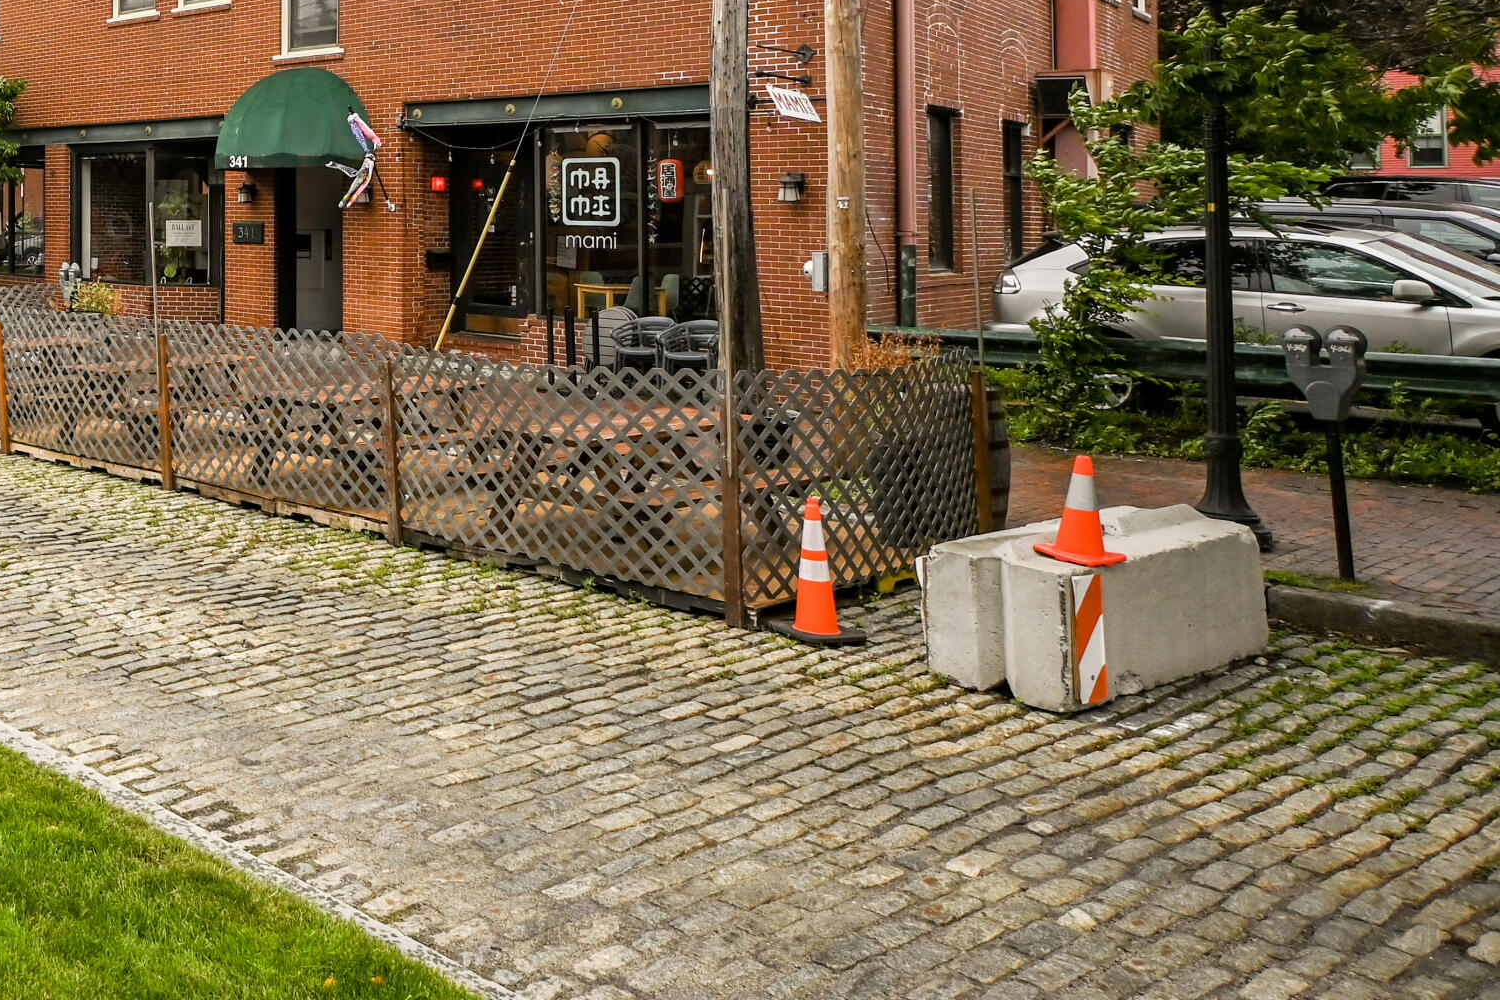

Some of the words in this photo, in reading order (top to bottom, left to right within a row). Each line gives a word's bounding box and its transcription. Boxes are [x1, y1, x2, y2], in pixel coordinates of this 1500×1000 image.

[771, 91, 809, 114] MAMI
[229, 155, 248, 168] 341
[171, 223, 196, 231] BALLAST
[237, 226, 255, 239] 341
[565, 232, 617, 249] mami
